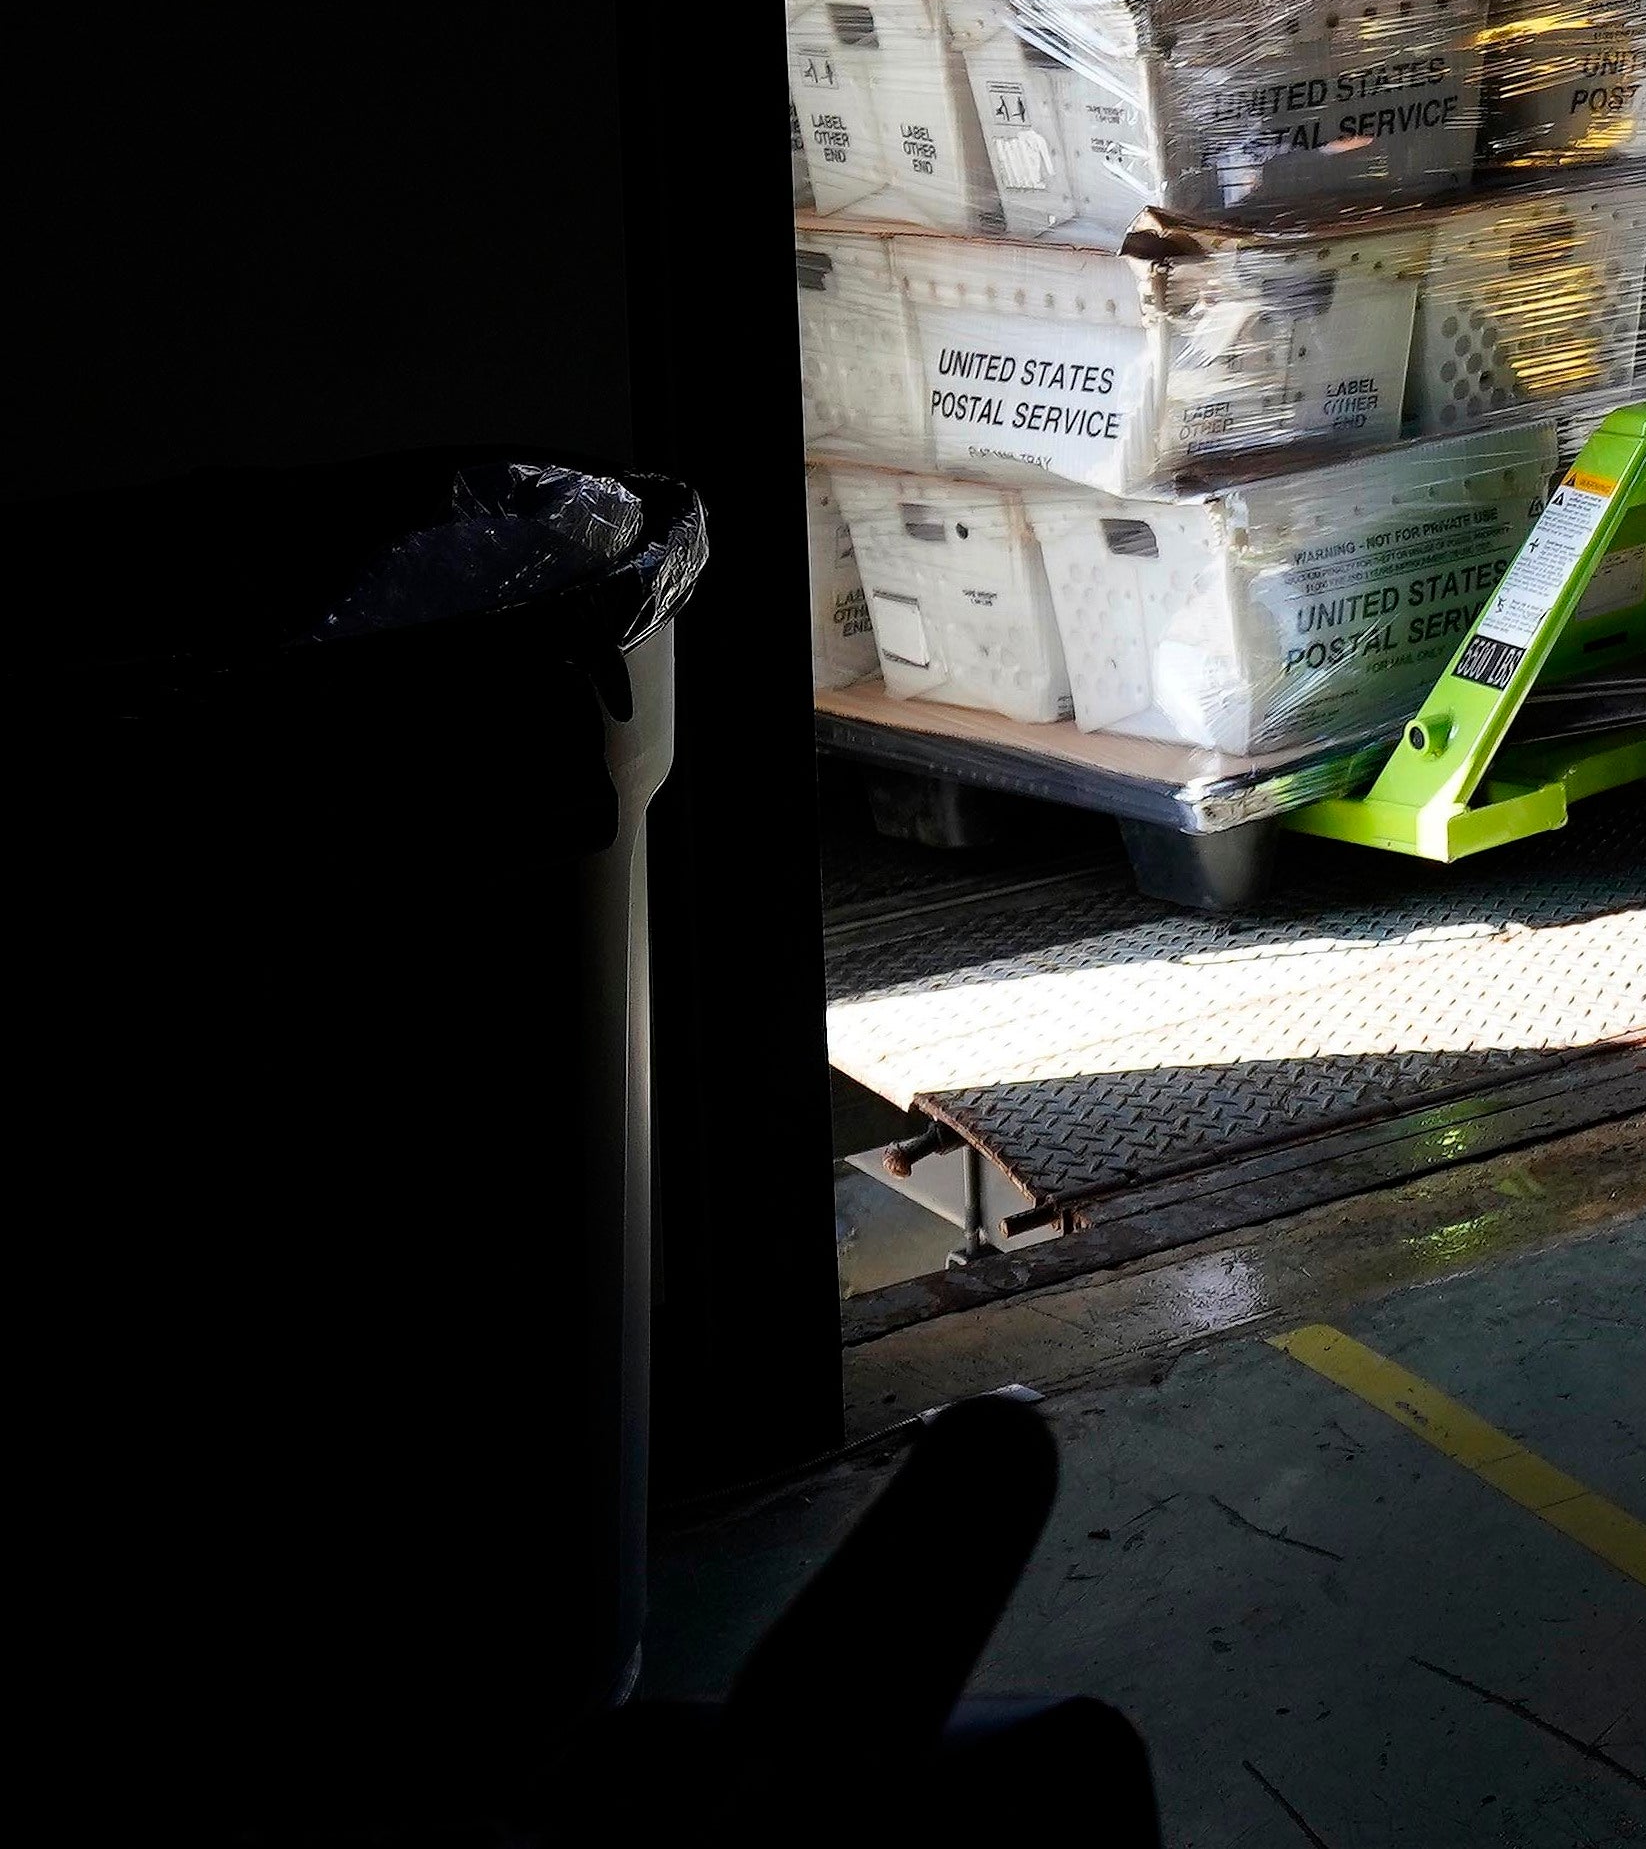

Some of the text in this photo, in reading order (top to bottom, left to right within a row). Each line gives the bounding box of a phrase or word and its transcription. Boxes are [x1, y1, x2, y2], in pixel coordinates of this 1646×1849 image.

[811, 113, 847, 131] LABEL
[1340, 95, 1457, 138] SERVICE
[814, 130, 850, 148] OTHER
[902, 141, 937, 159] OTHER
[824, 148, 847, 163] END
[912, 159, 934, 174] END
[939, 348, 1115, 394] UNITED STATES
[1326, 378, 1378, 398] LABEL
[931, 390, 1121, 439] POSTAL SERVICE
[1294, 542, 1356, 566] WARNING
[1366, 532, 1391, 550] NOT
[1395, 525, 1420, 543] FOR
[1422, 514, 1471, 536] PRIVATE
[1297, 587, 1400, 635] UNITED
[1283, 624, 1398, 674] POSTAL
[1408, 603, 1484, 645] SERV
